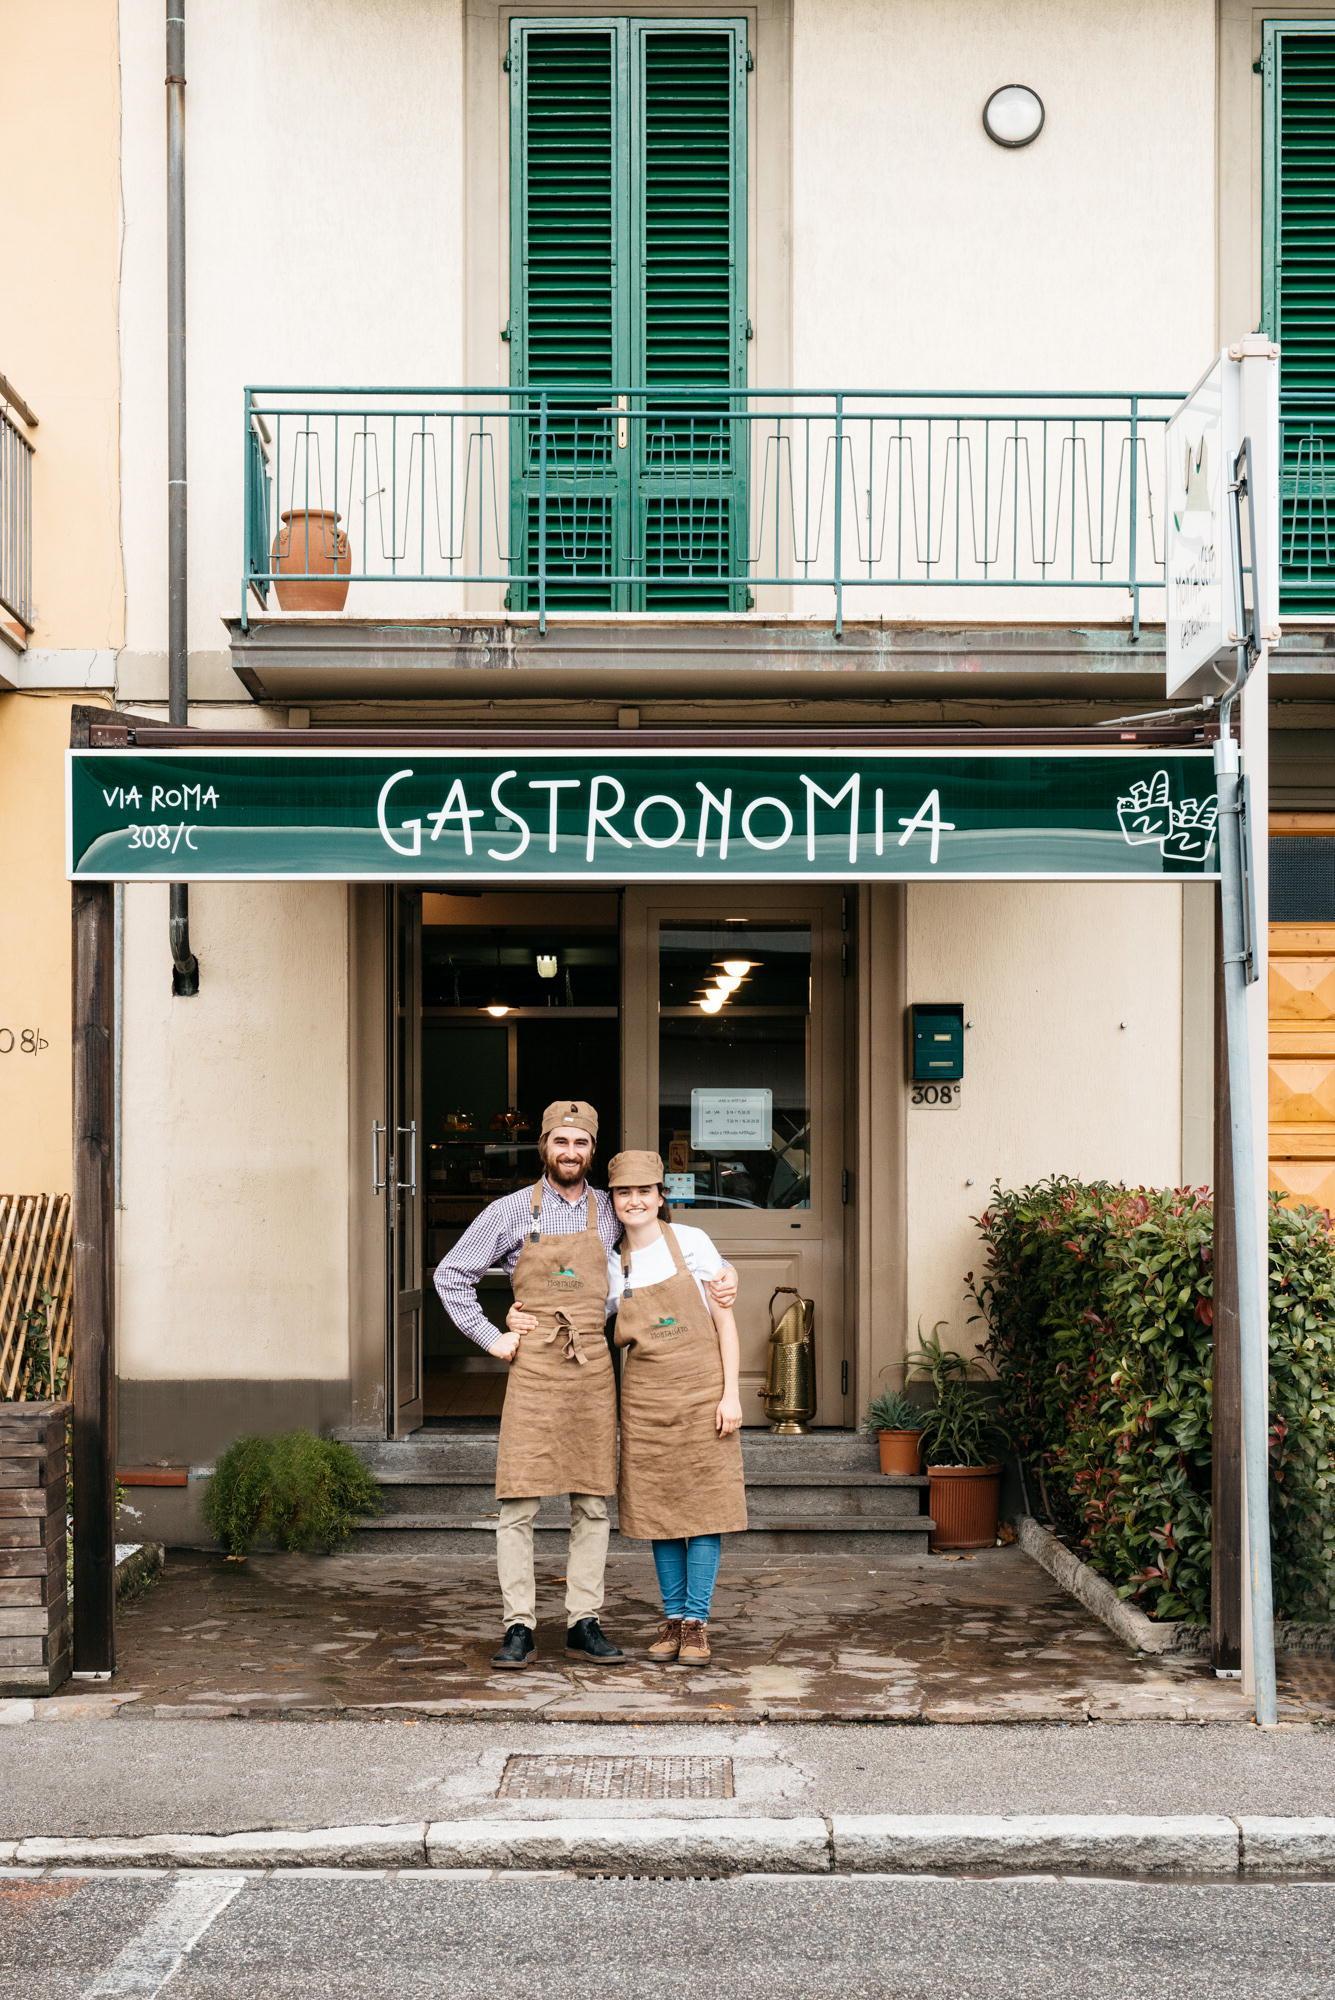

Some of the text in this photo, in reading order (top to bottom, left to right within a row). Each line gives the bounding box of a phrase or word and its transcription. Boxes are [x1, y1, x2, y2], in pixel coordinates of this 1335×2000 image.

[102, 783, 220, 812] VIA ROMA
[377, 769, 956, 864] GASTRONOMIA
[128, 821, 198, 854] 308/C
